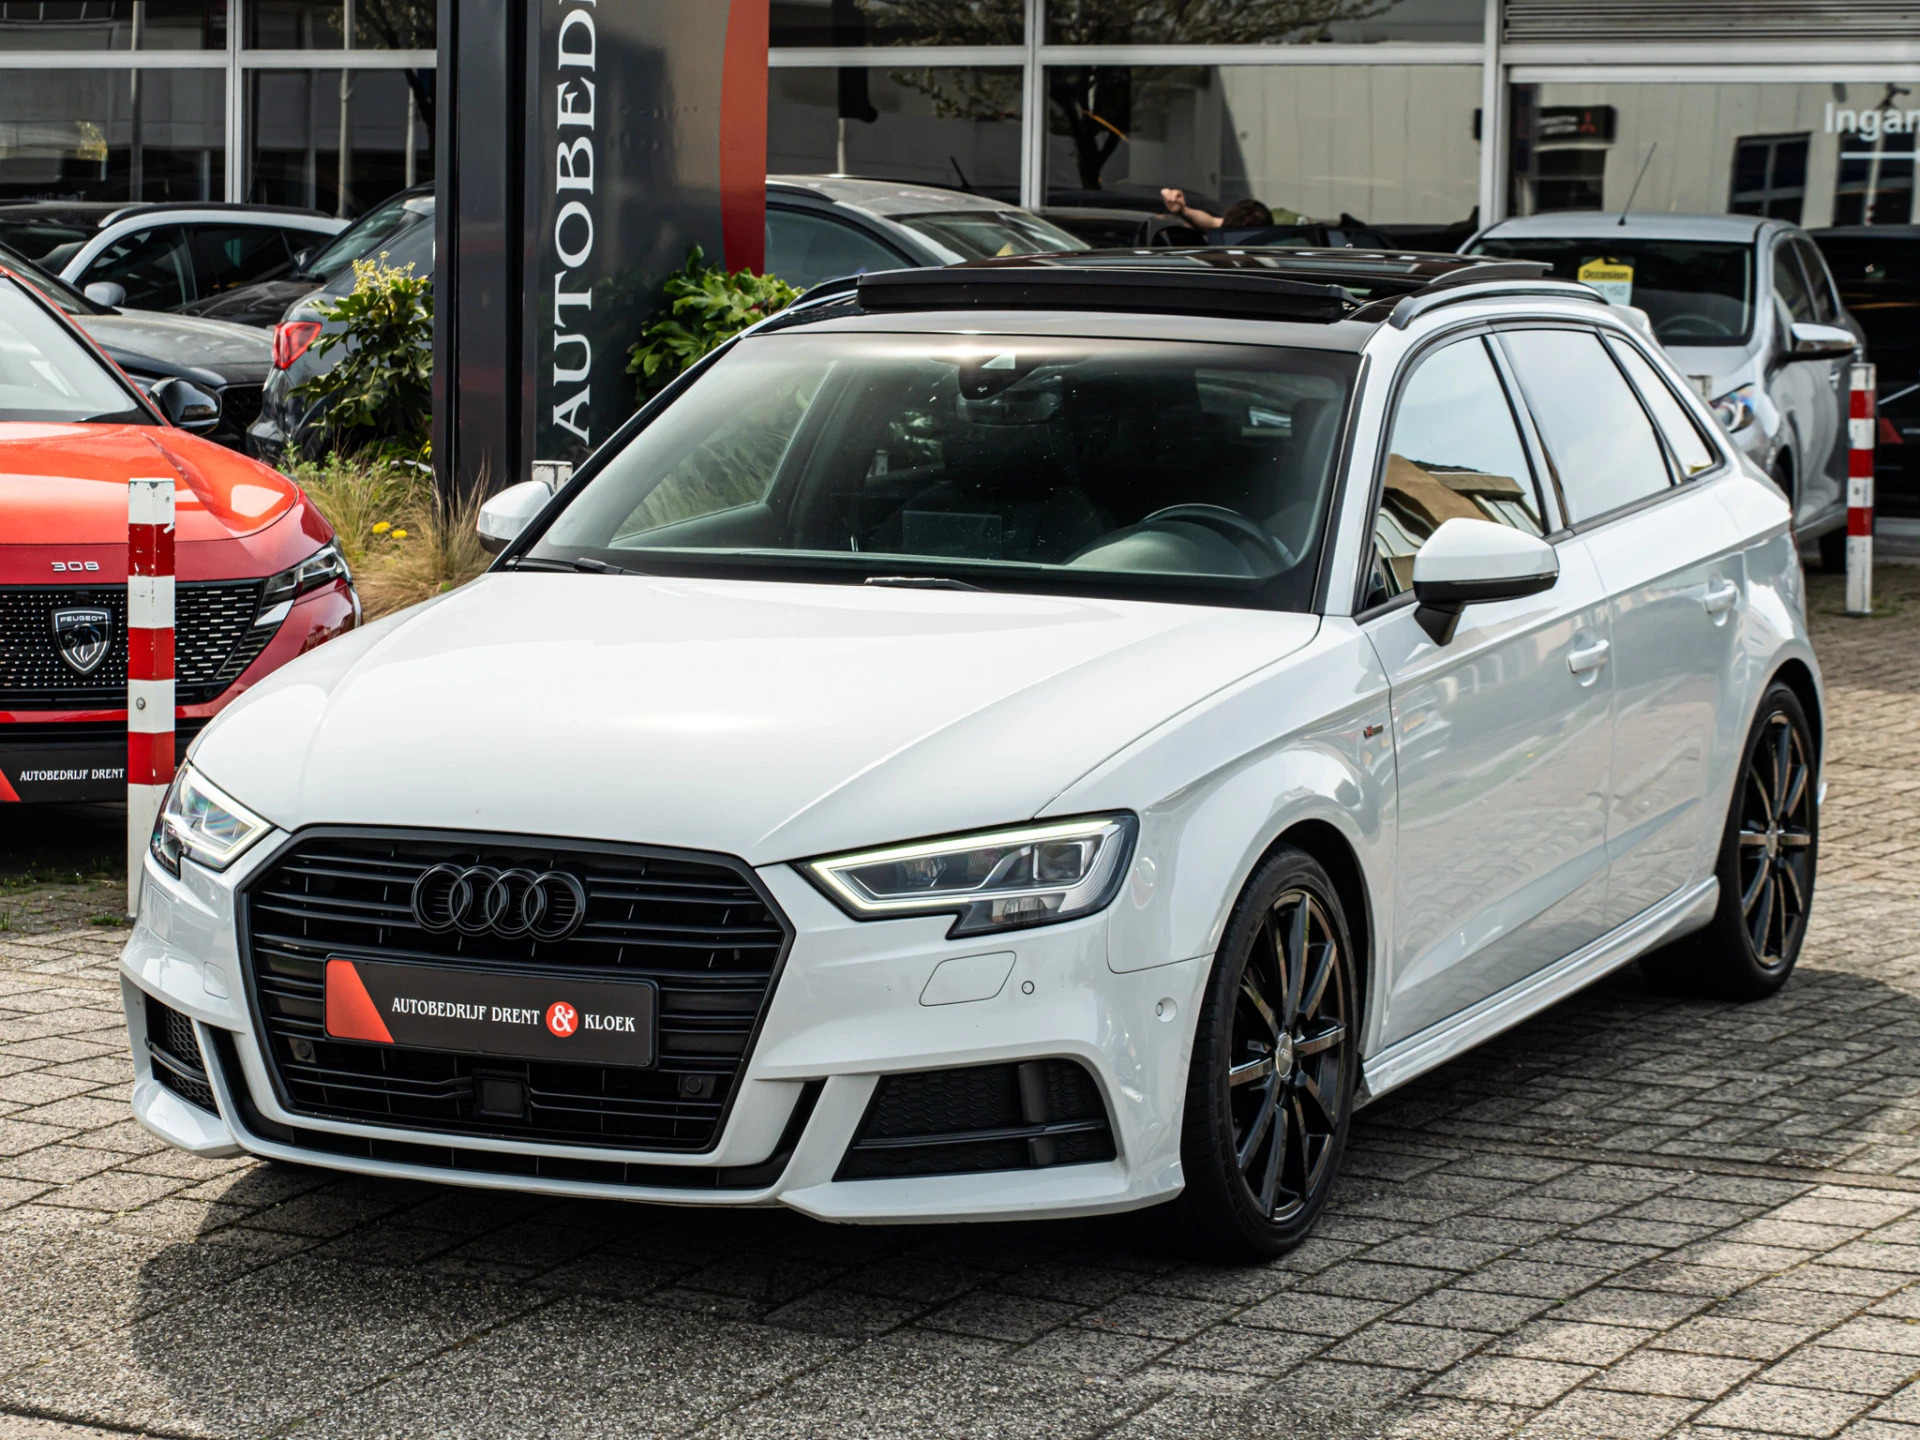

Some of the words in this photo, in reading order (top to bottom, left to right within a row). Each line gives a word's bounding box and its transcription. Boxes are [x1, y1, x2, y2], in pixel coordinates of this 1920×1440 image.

[552, 0, 597, 446] AUTOBED
[1582, 269, 1630, 280] Occasion
[51, 561, 100, 572] 308
[60, 615, 103, 623] PEUGEOT
[19, 769, 88, 781] AUTOBEDRIJF
[91, 768, 125, 780] DRENT
[392, 998, 487, 1021] AUTOBEDRIJF
[491, 1006, 540, 1025] DRENT
[551, 1004, 574, 1033] &
[585, 1014, 636, 1032] KLOEK
